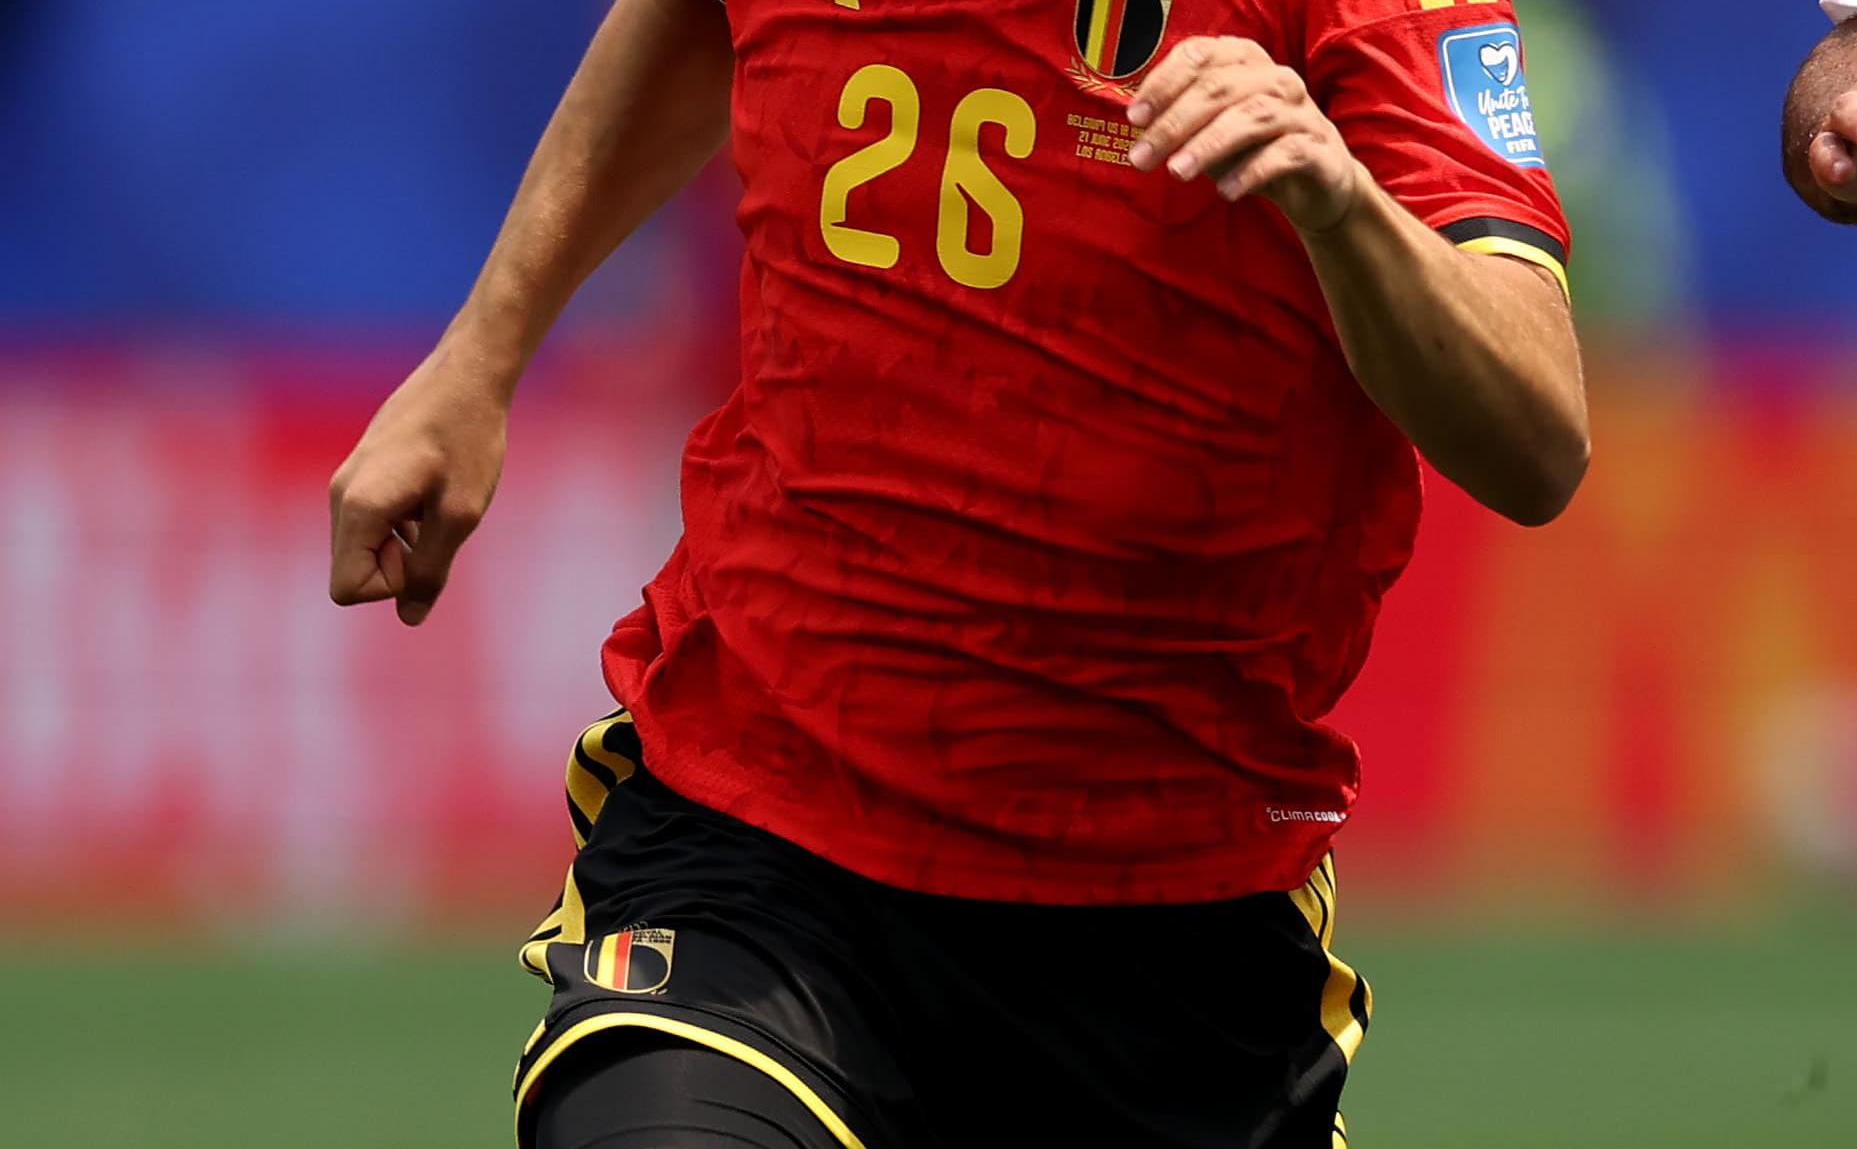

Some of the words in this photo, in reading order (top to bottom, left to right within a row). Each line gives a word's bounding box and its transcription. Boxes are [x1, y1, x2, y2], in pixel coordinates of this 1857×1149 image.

[1079, 131, 1090, 143] 21
[1095, 148, 1132, 166] ANGELE
[820, 63, 1037, 290] 26
